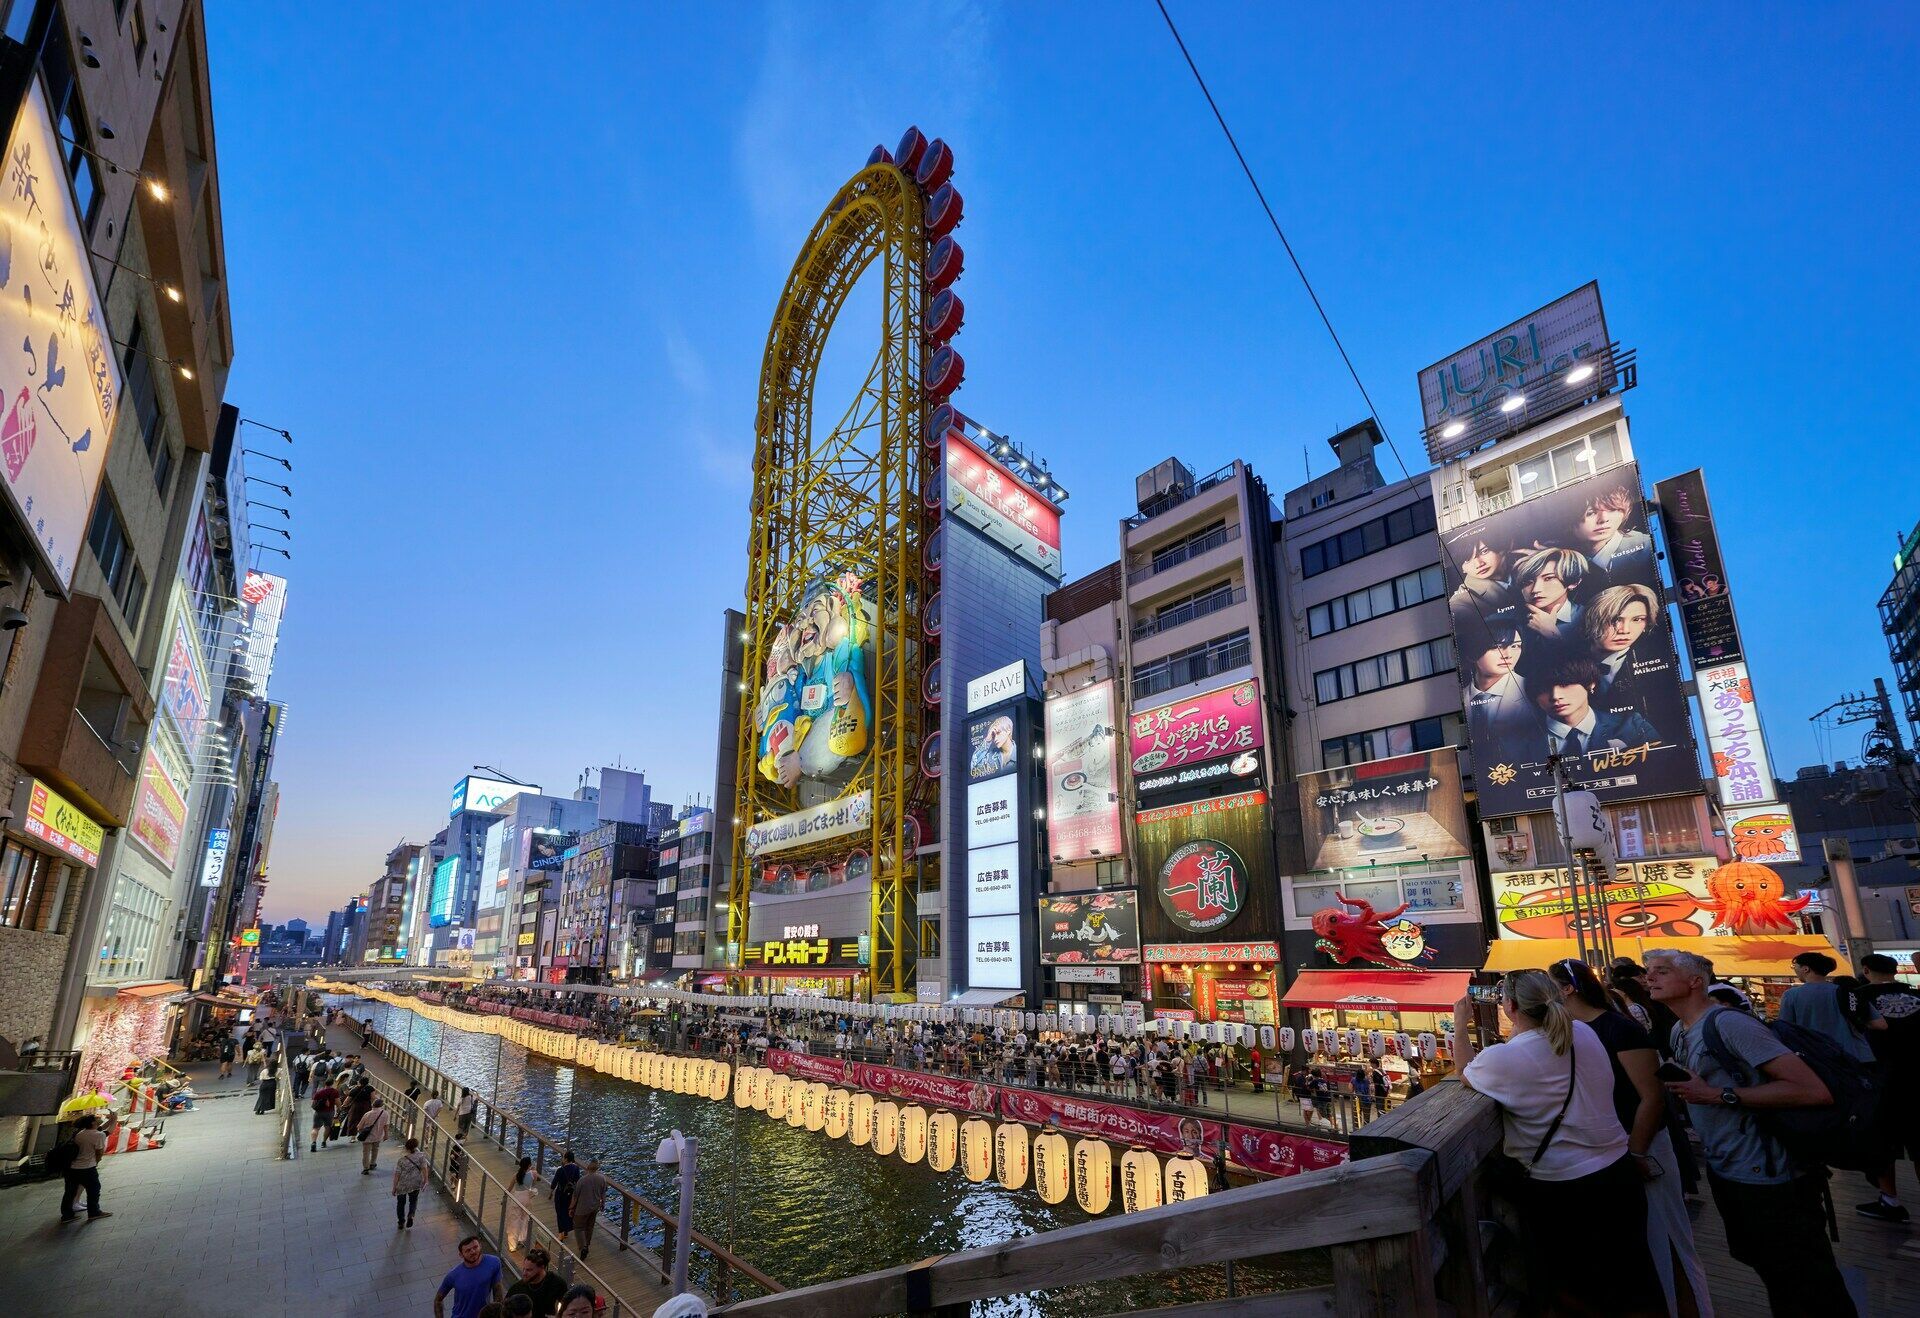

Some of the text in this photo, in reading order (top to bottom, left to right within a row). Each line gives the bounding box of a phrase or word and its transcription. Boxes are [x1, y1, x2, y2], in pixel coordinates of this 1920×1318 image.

[1436, 322, 1541, 415] JURI
[998, 498, 1015, 518] Tax
[1018, 513, 1039, 535] Free
[1611, 544, 1644, 558] Katsuki
[1497, 605, 1515, 613] Lynn
[1633, 658, 1661, 668] Kurea
[1634, 663, 1669, 675] Mikami
[1706, 667, 1736, 681] 元祖
[983, 671, 1022, 698] BRAVE
[1709, 677, 1739, 692] 大阪
[1610, 705, 1634, 714] Neru
[1134, 705, 1200, 739] 世界一
[1150, 714, 1230, 752] 人が訪れる
[1174, 726, 1254, 763] ラーメン店
[1714, 692, 1764, 801] あっちち本舗
[1593, 741, 1662, 773] WEST
[1593, 780, 1611, 788] 大阪
[976, 799, 1008, 816] 広告募集
[213, 831, 228, 850] 焼肉
[1164, 843, 1199, 876] ICHIRAN
[977, 869, 1009, 883] 広告募集
[1164, 850, 1238, 912] 一蘭
[1505, 874, 1536, 887] 元祖
[784, 924, 820, 939] 激安の殿堂
[978, 941, 1010, 952] 広告募集
[1269, 1143, 1295, 1161] 30
